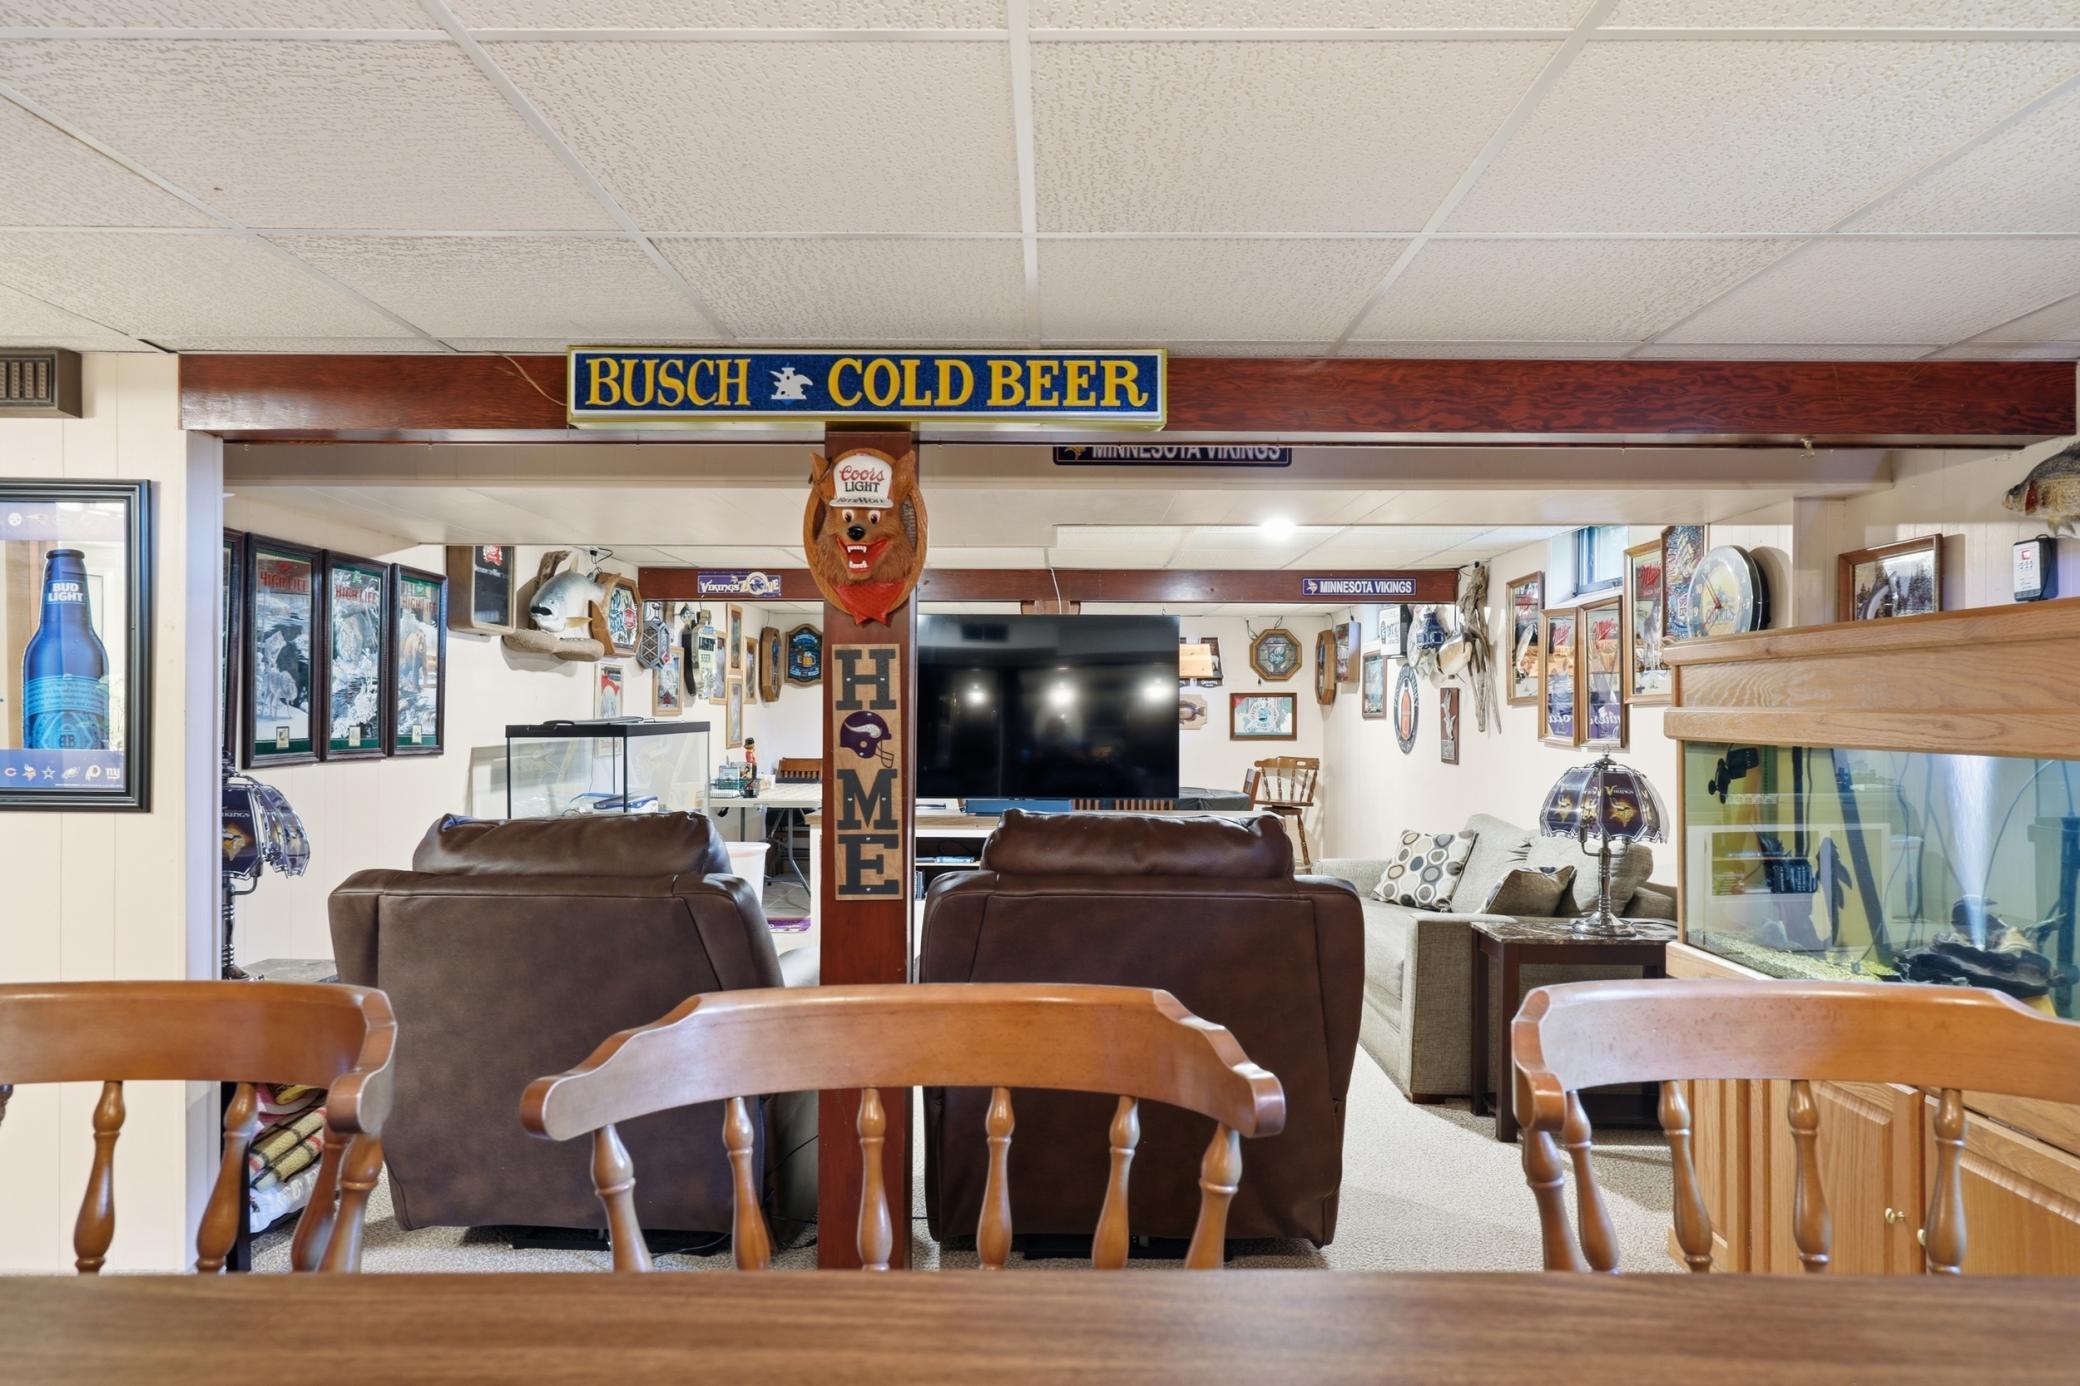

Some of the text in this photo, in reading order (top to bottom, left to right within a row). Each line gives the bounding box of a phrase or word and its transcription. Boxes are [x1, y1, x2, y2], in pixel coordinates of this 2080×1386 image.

[585, 357, 1149, 407] BUSCH COLD BEER
[839, 465, 884, 481] Coors
[845, 481, 880, 492] LIGHT
[53, 583, 79, 592] BUD
[1320, 581, 1411, 593] MINNESOTA VIKINGS
[48, 592, 83, 602] LIGHT
